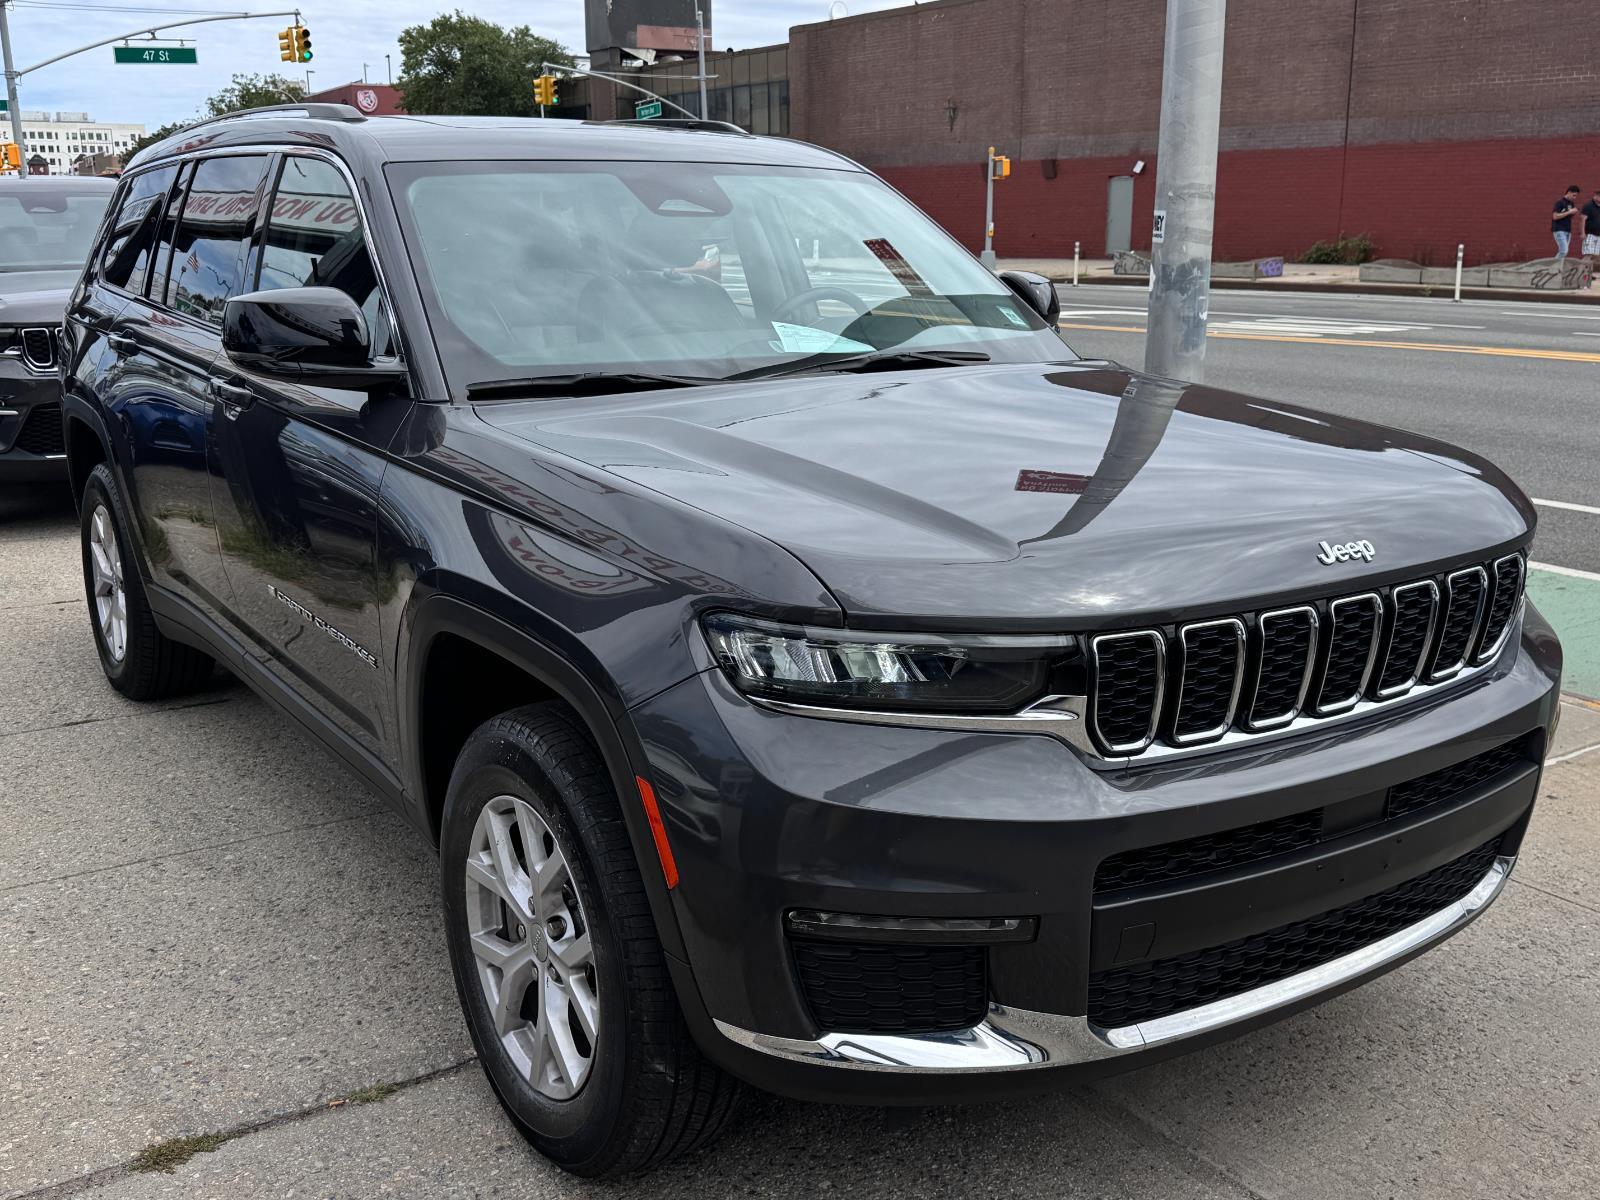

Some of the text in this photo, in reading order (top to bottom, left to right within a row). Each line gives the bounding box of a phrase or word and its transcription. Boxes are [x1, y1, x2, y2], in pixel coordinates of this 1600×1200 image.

[142, 50, 170, 61] 47 St
[1317, 540, 1376, 566] Jeep
